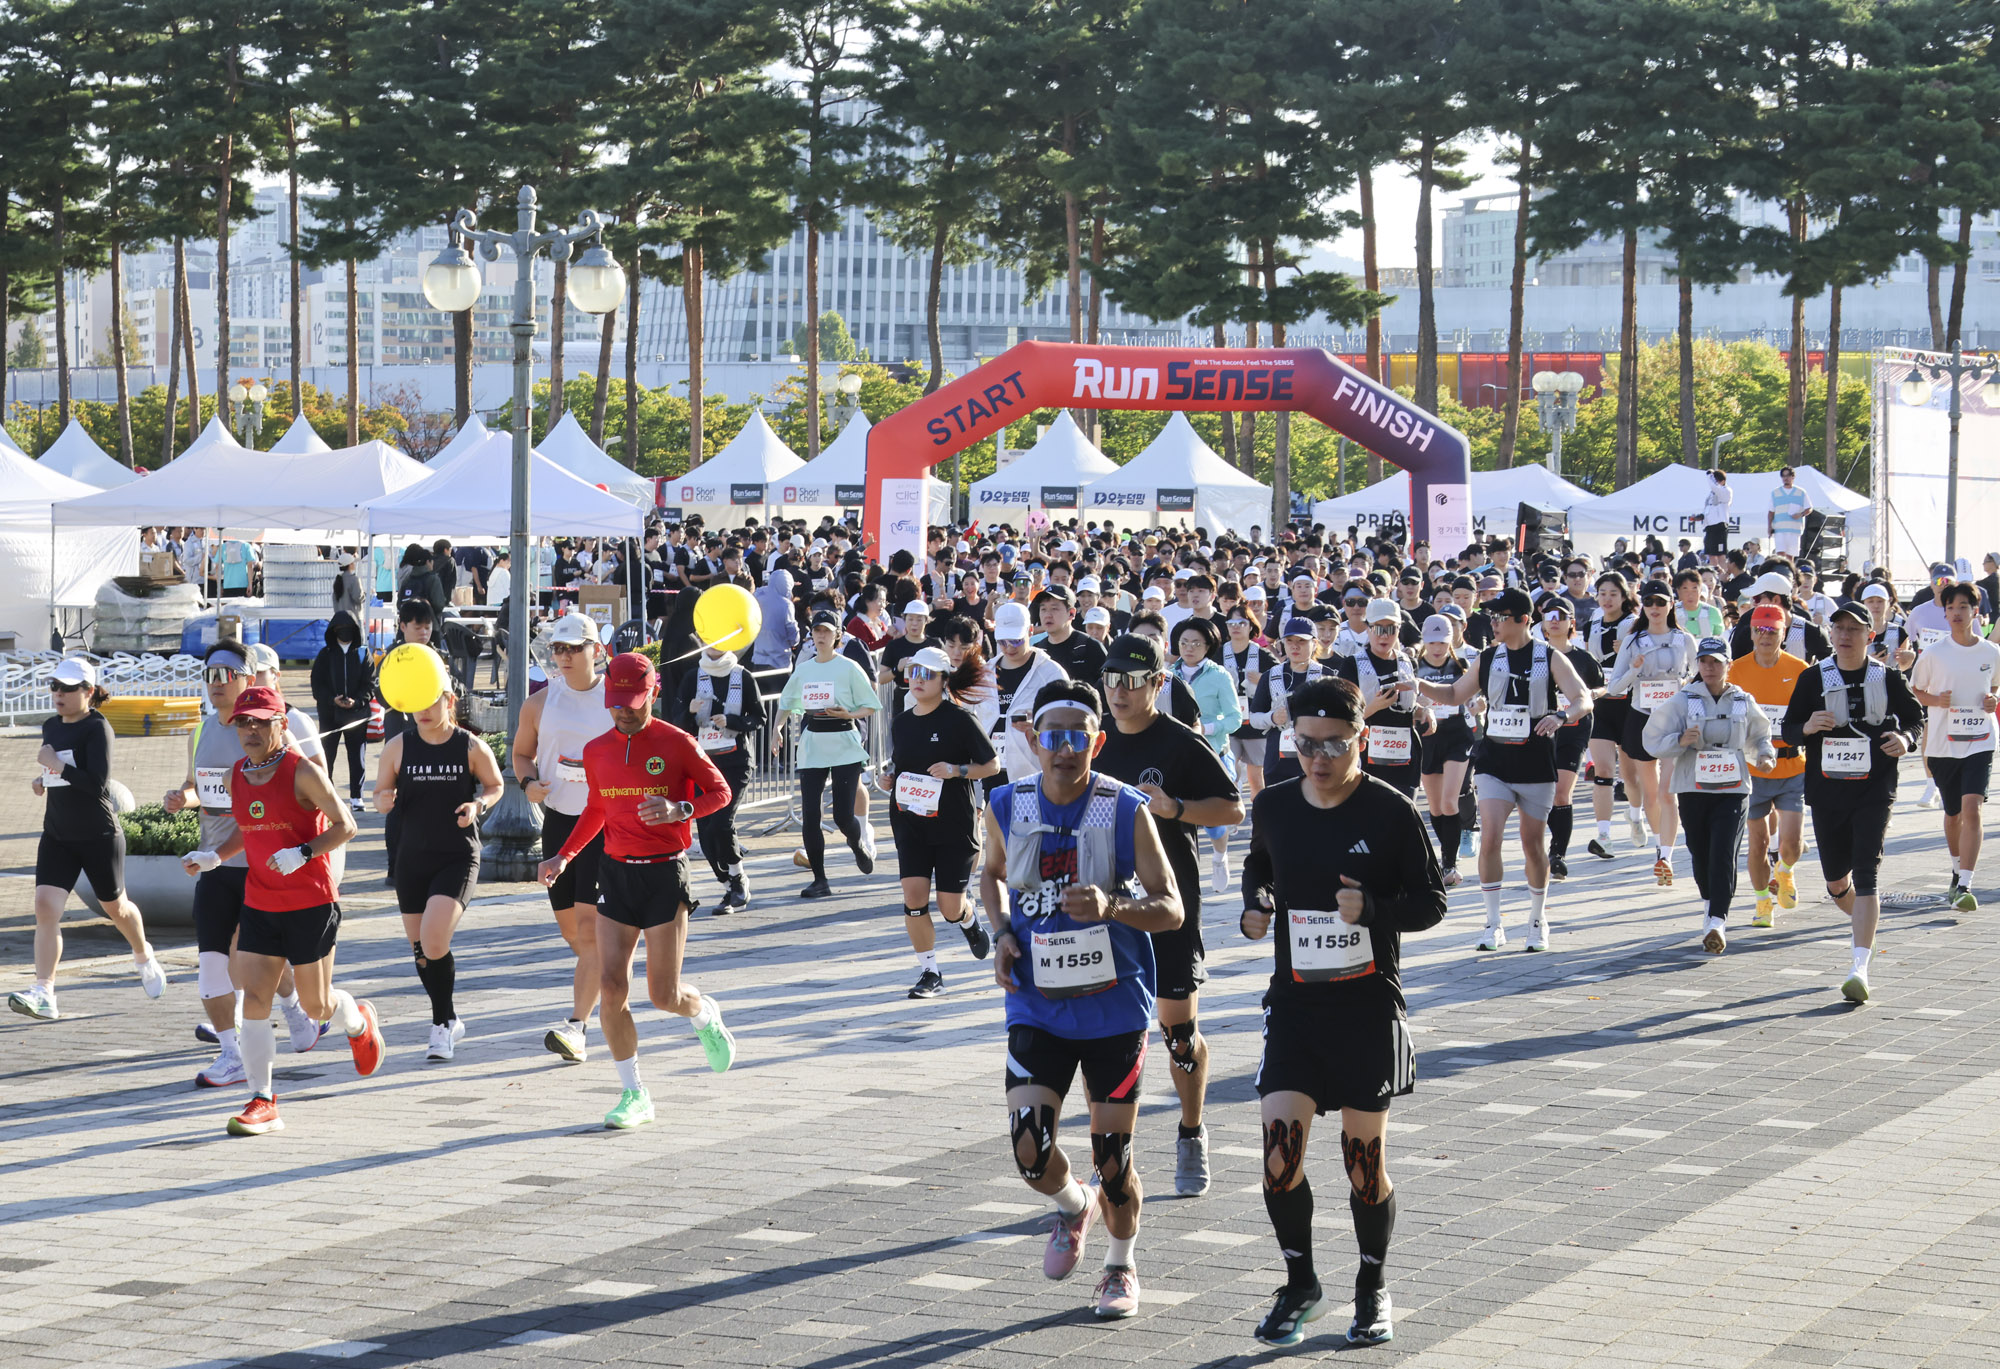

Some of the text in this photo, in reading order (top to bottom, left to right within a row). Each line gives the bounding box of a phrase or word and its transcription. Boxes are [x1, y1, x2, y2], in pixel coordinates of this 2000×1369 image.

[313, 322, 323, 346] 12
[927, 370, 1026, 445] START
[1333, 375, 1435, 453] FINISH
[992, 490, 1031, 504] 오늘덤핑
[1107, 492, 1146, 506] 오늘덤핑
[1633, 515, 1741, 534] MC 대실
[809, 692, 830, 701] 2559
[1962, 718, 1985, 726] 1837
[1383, 739, 1408, 749] 2266
[1836, 752, 1865, 761] 1247
[406, 764, 464, 774] TEAM VARO
[1709, 763, 1735, 773] 2155
[909, 787, 936, 799] 2627
[1298, 931, 1361, 949] M 1558
[1040, 950, 1103, 969] M 1559
